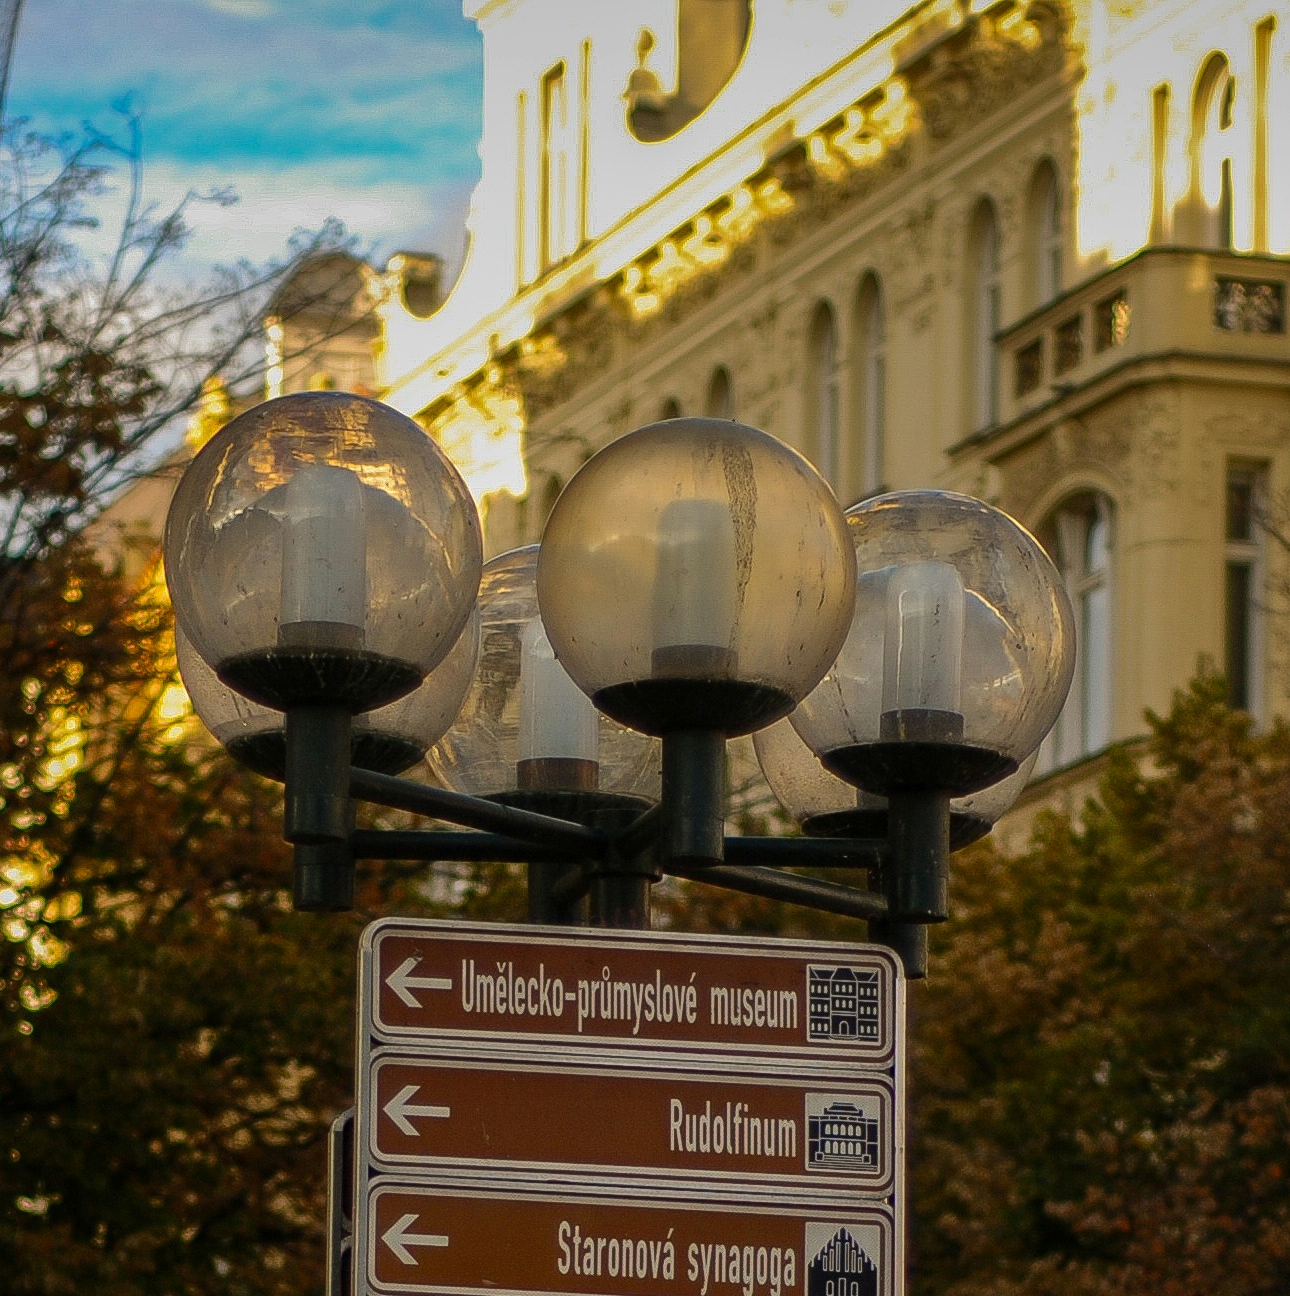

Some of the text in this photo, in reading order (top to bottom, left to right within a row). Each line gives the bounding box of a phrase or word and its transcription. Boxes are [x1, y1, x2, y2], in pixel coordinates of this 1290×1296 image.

[461, 958, 797, 1034] Umělecko-průmyslové museum
[670, 1098, 796, 1157] Rudolfinum
[558, 1221, 674, 1280] Staronová
